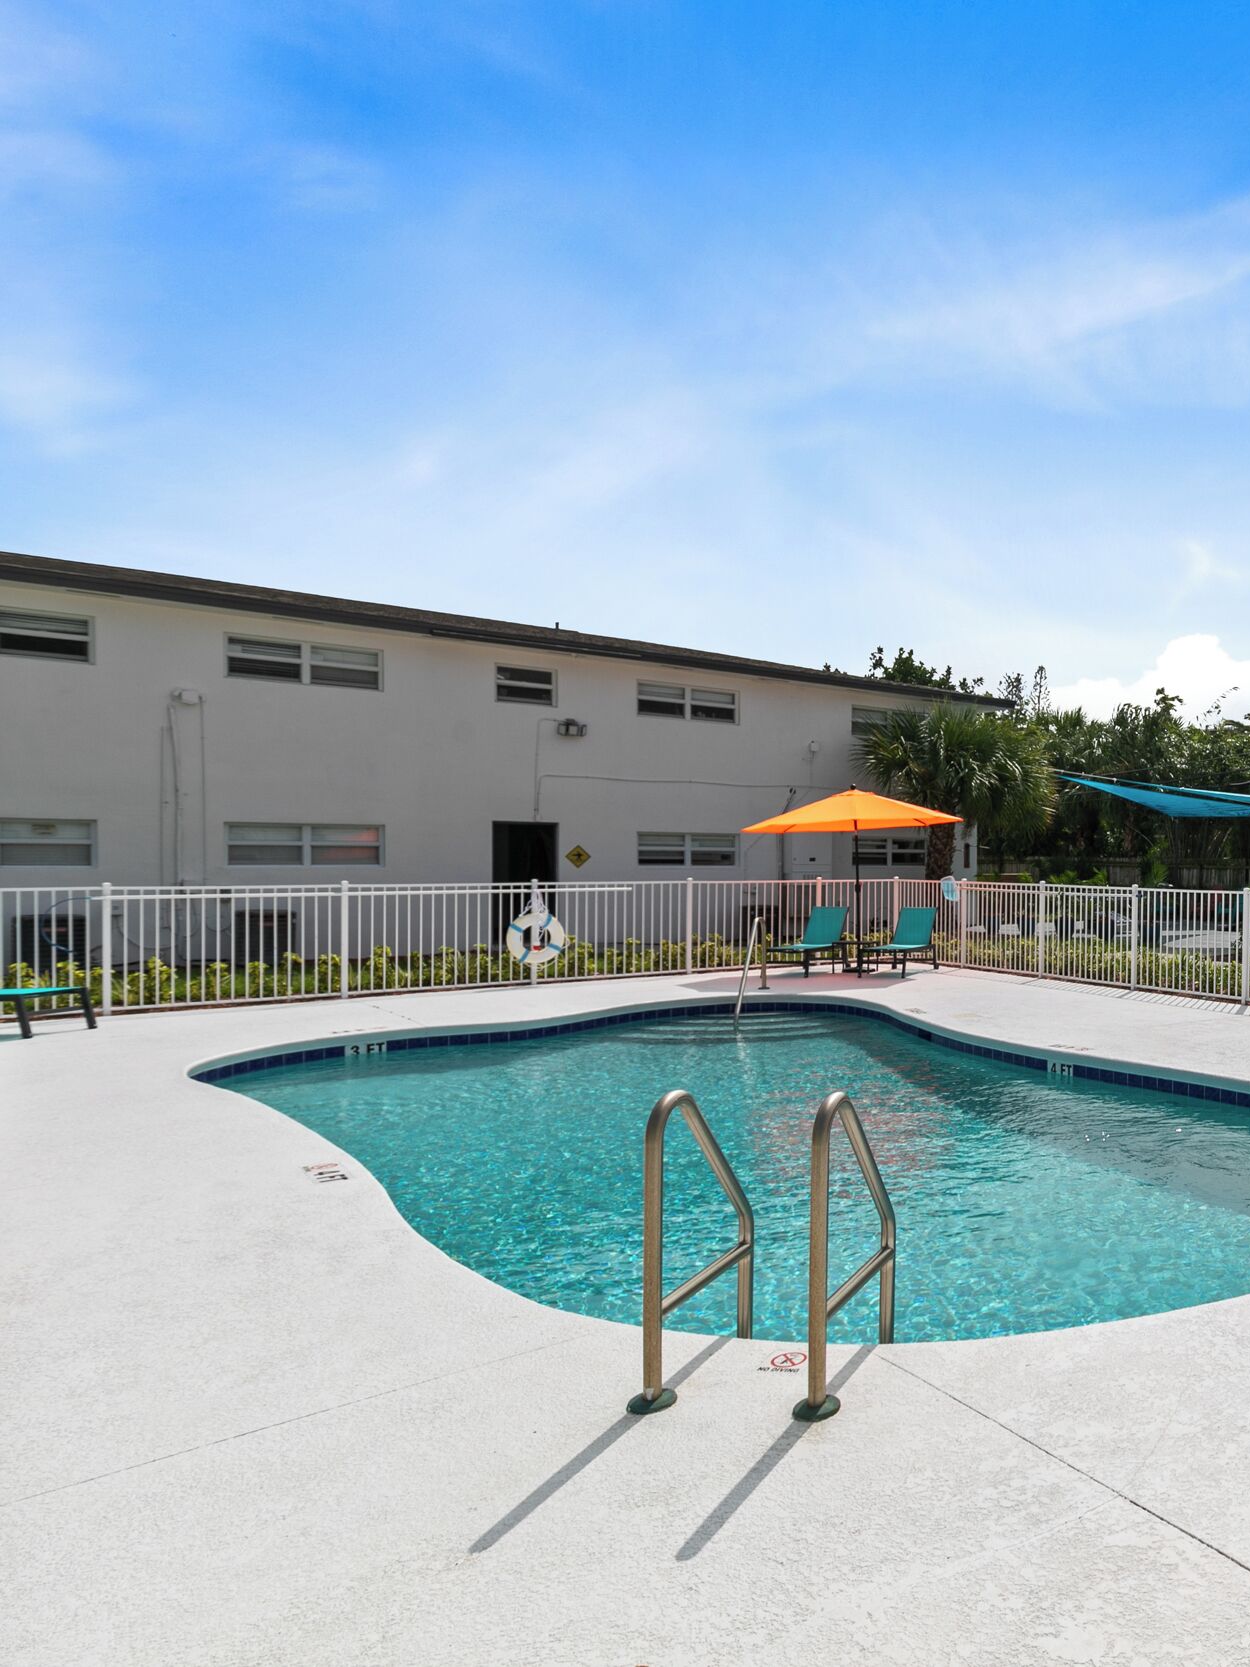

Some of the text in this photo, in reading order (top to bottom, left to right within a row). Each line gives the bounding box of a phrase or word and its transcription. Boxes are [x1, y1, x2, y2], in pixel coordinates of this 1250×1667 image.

[350, 1042, 385, 1056] 3 FT
[1050, 1062, 1072, 1076] 4 FT
[315, 1173, 349, 1183] FT
